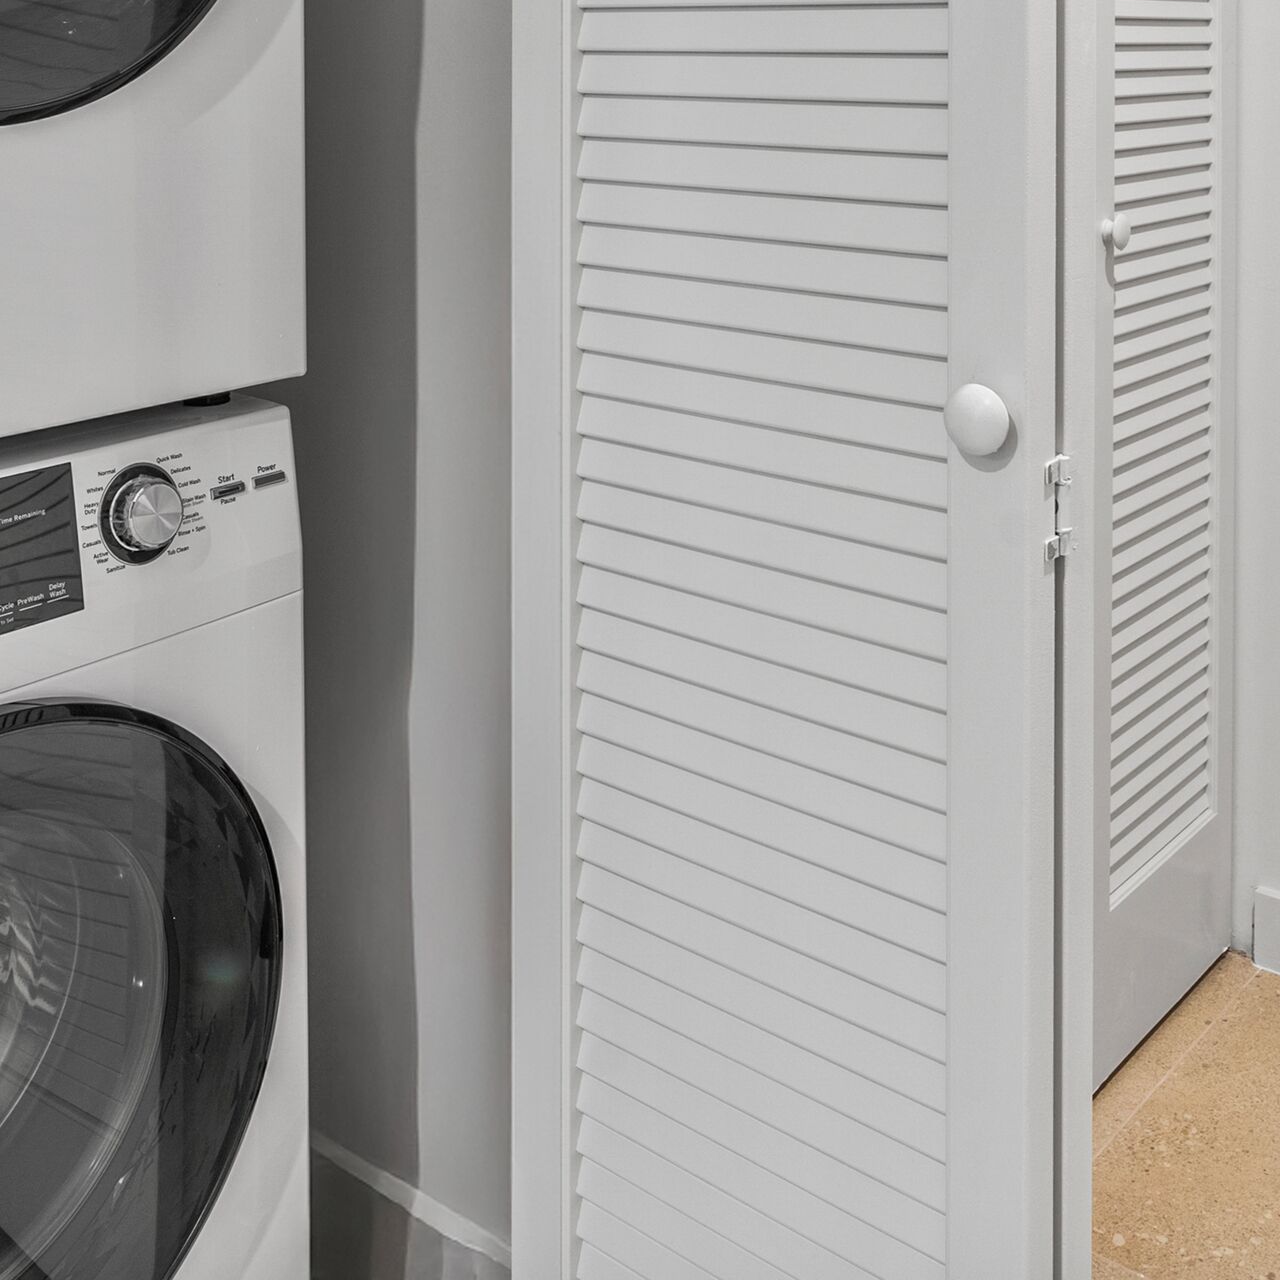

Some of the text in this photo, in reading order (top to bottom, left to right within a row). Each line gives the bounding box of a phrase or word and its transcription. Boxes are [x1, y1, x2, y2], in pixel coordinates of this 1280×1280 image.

[156, 452, 183, 464] Quick Wash
[98, 468, 116, 477] Normal
[170, 465, 191, 475] Delicates
[257, 463, 276, 473] Power
[189, 478, 201, 486] Wash
[218, 474, 235, 483] Start
[86, 486, 103, 495] Whites
[193, 493, 206, 501] Wash
[220, 497, 236, 505] Pause
[84, 502, 99, 510] Heavy
[14, 509, 46, 521] Remaining
[84, 508, 96, 516] Duty
[183, 512, 199, 520] Casuals
[81, 523, 97, 532] Towels
[178, 529, 191, 537] Rinse
[195, 525, 206, 534] Spin
[82, 540, 102, 549] Casuals
[167, 545, 190, 556] Tub Clean
[93, 551, 109, 560] Active
[96, 557, 109, 565] Wear
[106, 564, 126, 574] Sanitize
[49, 581, 66, 592] Delay
[49, 588, 66, 598] Wash
[17, 593, 44, 606] PreWash
